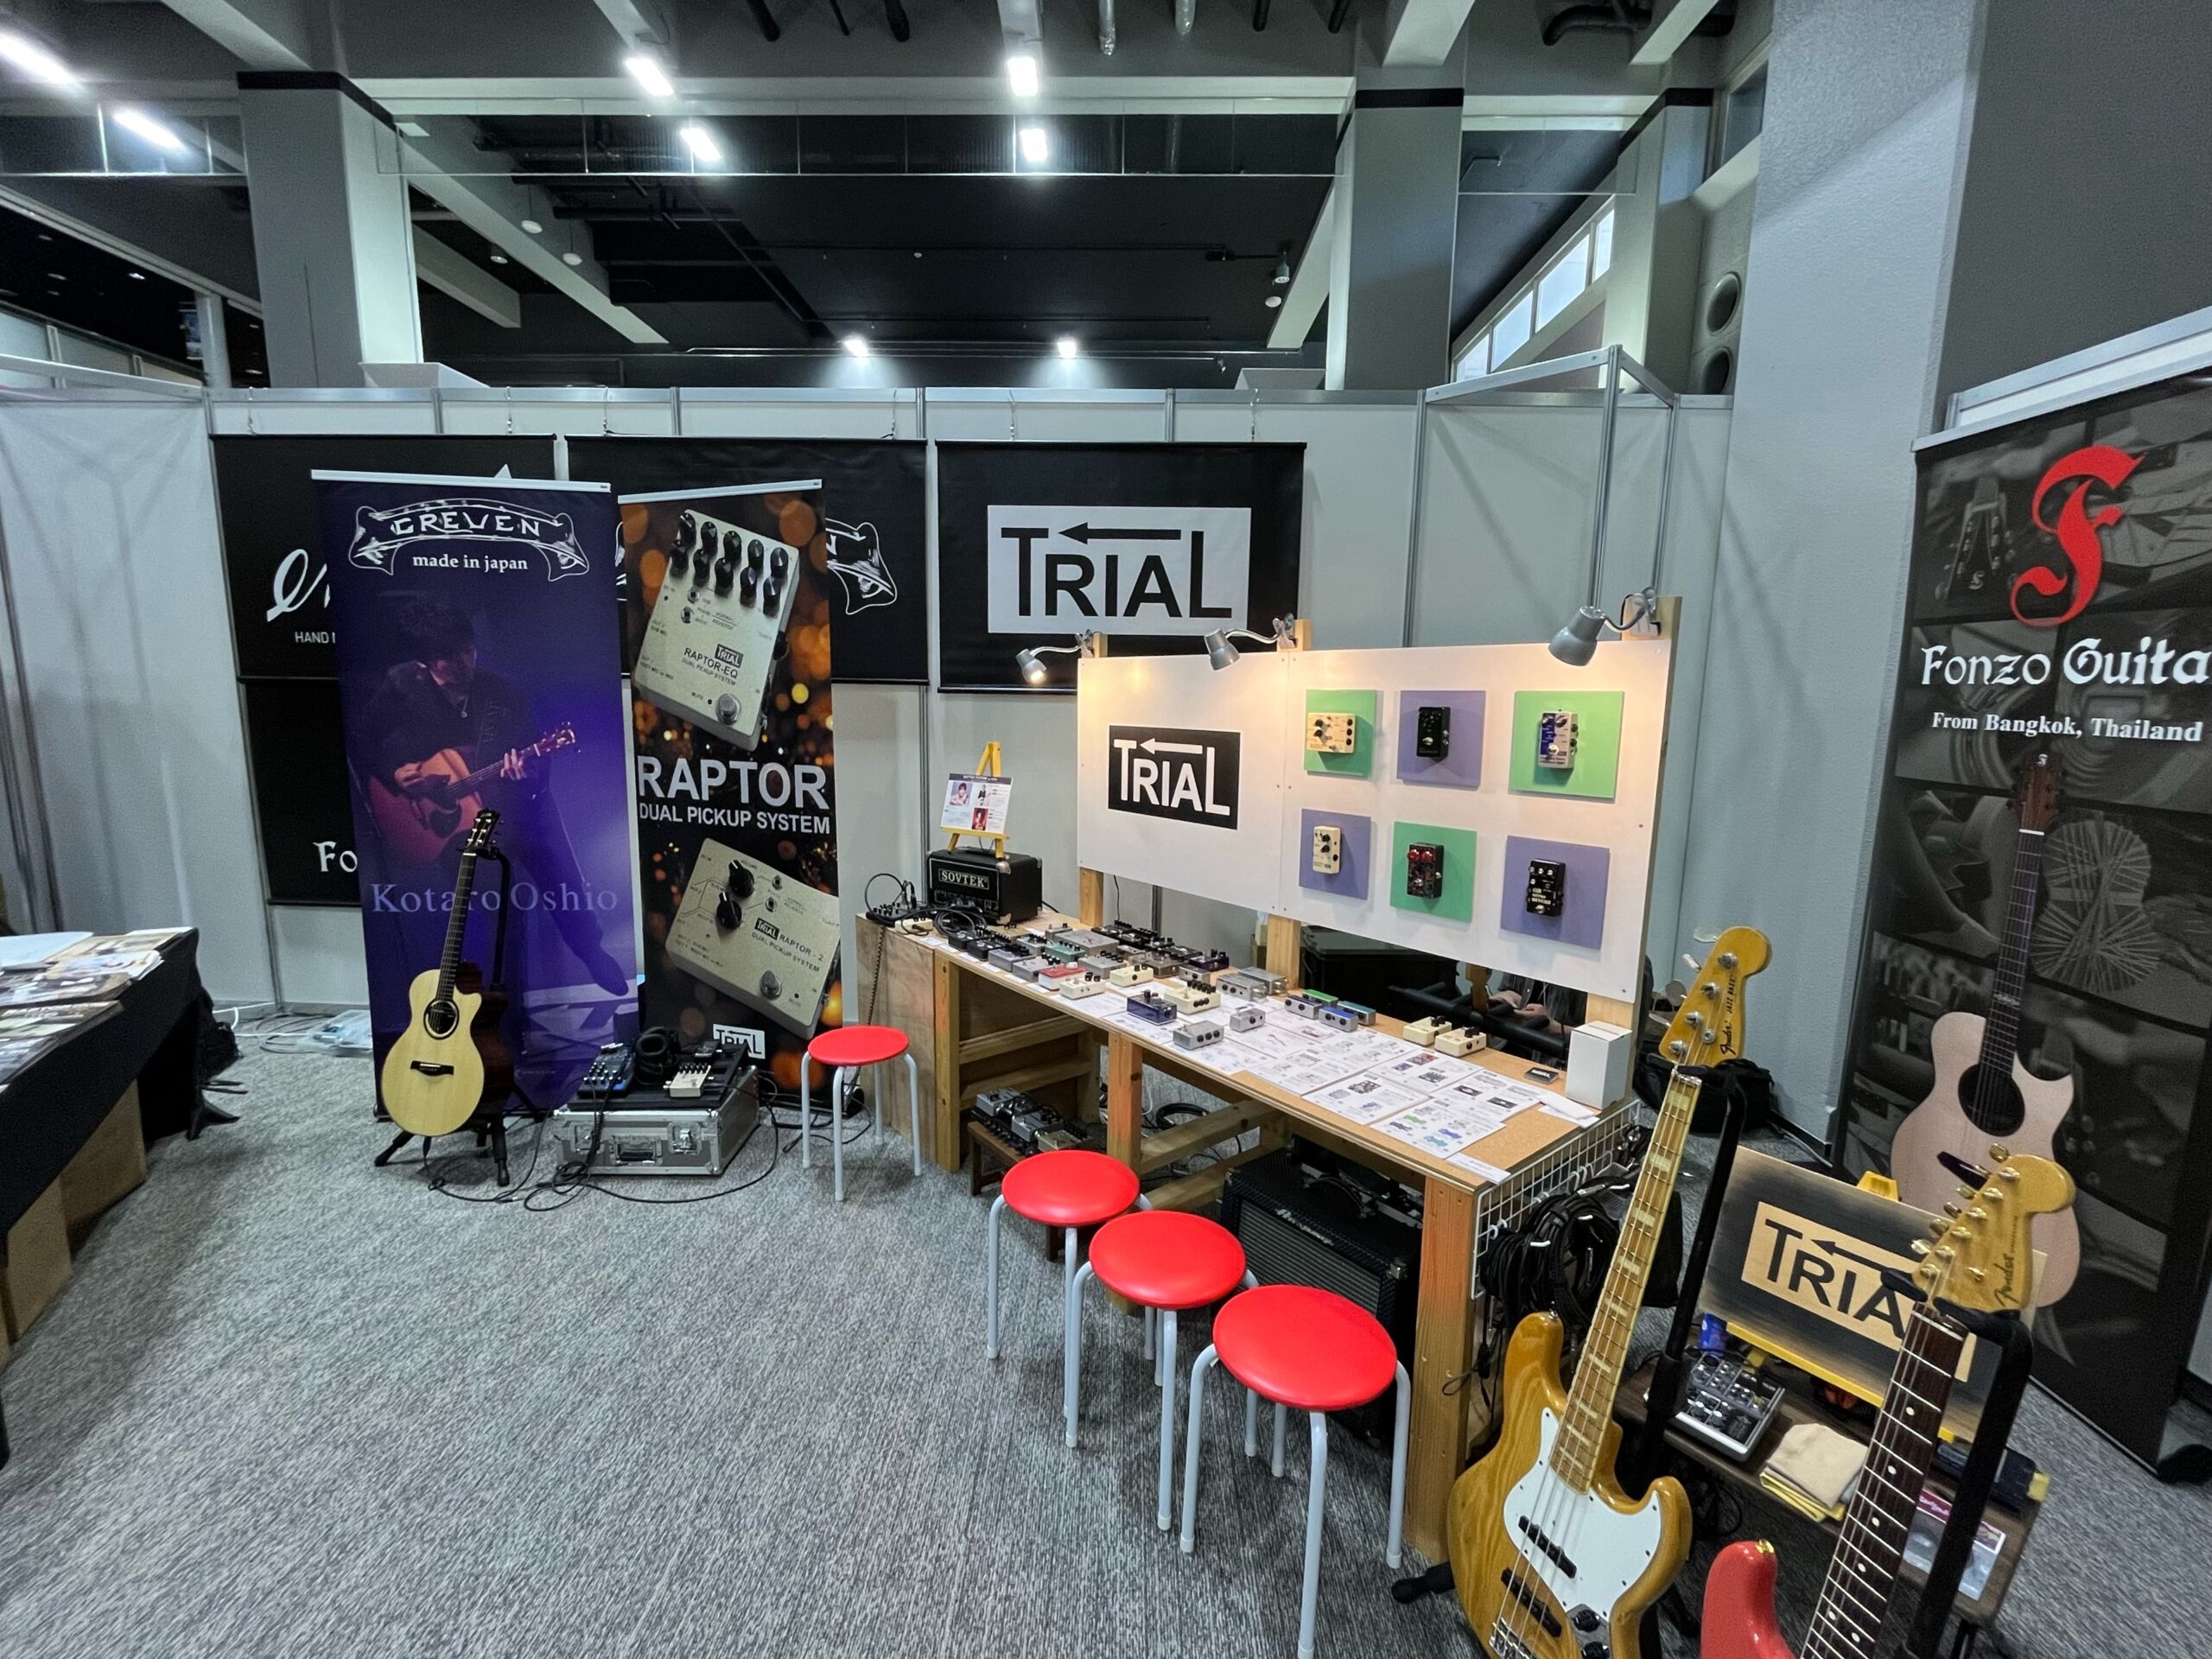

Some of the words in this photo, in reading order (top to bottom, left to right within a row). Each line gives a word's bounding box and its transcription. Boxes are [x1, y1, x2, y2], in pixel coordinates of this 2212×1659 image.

[391, 512, 540, 537] GREVEN
[412, 554, 459, 568] made
[464, 555, 480, 569] in
[485, 555, 528, 573] japan
[1001, 527, 1232, 619] TRIAL
[295, 632, 329, 644] HAND
[683, 647, 739, 679] RAPTOR-EQ
[716, 646, 741, 668] TRIAL
[1920, 645, 2051, 685] Fonzo
[2063, 636, 2212, 685] Guita
[715, 673, 736, 686] SYSTEM
[1931, 712, 1978, 729] From
[1984, 714, 2082, 737] Bangkok,
[2091, 717, 2203, 741] Thailand
[637, 755, 830, 810] RAPTOR
[1113, 738, 1230, 817] TRIAL
[639, 802, 683, 823] DUAL
[687, 808, 752, 828] PICKUP
[757, 811, 830, 835] SYSTEM
[312, 841, 358, 873] Fo
[941, 870, 984, 888] SOVTEK
[371, 884, 500, 912] Kotaro
[511, 881, 618, 911] Oshio
[756, 918, 779, 940] TRIAL
[779, 933, 812, 957] RAPTOR
[769, 940, 792, 959] PICKUP
[792, 955, 820, 972] SYSTEM
[1765, 1218, 1906, 1340] TRIA
[1993, 1253, 2019, 1307] Fender
